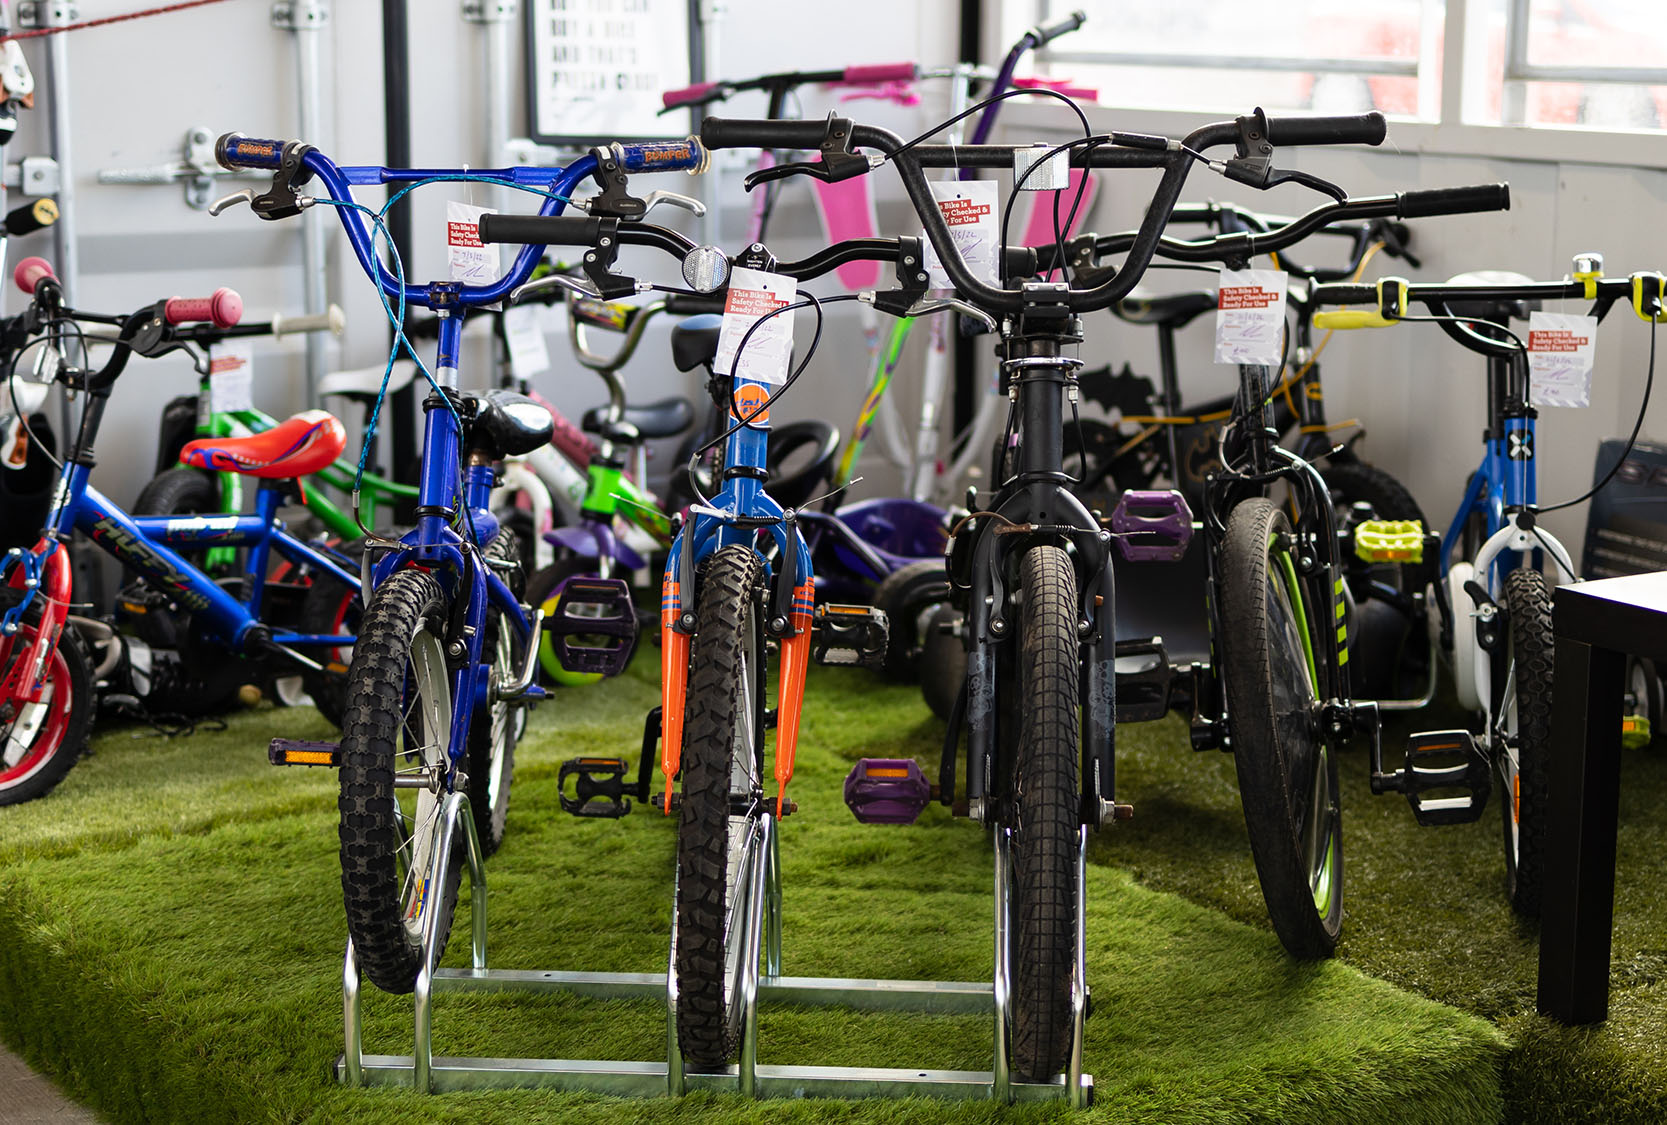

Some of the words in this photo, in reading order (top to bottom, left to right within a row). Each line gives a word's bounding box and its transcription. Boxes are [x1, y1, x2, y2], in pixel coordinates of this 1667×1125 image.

[645, 148, 691, 163] BUMPER
[944, 202, 960, 210] Bike
[951, 206, 981, 217] Checked
[950, 216, 963, 224] For
[963, 215, 977, 223] Use
[451, 230, 464, 239] Safety
[451, 237, 464, 245] Ready
[464, 238, 473, 246] For
[733, 289, 748, 298] This
[749, 291, 765, 299] Bike
[731, 297, 754, 307] Safety
[754, 300, 782, 309] Checked
[730, 305, 751, 314] Ready
